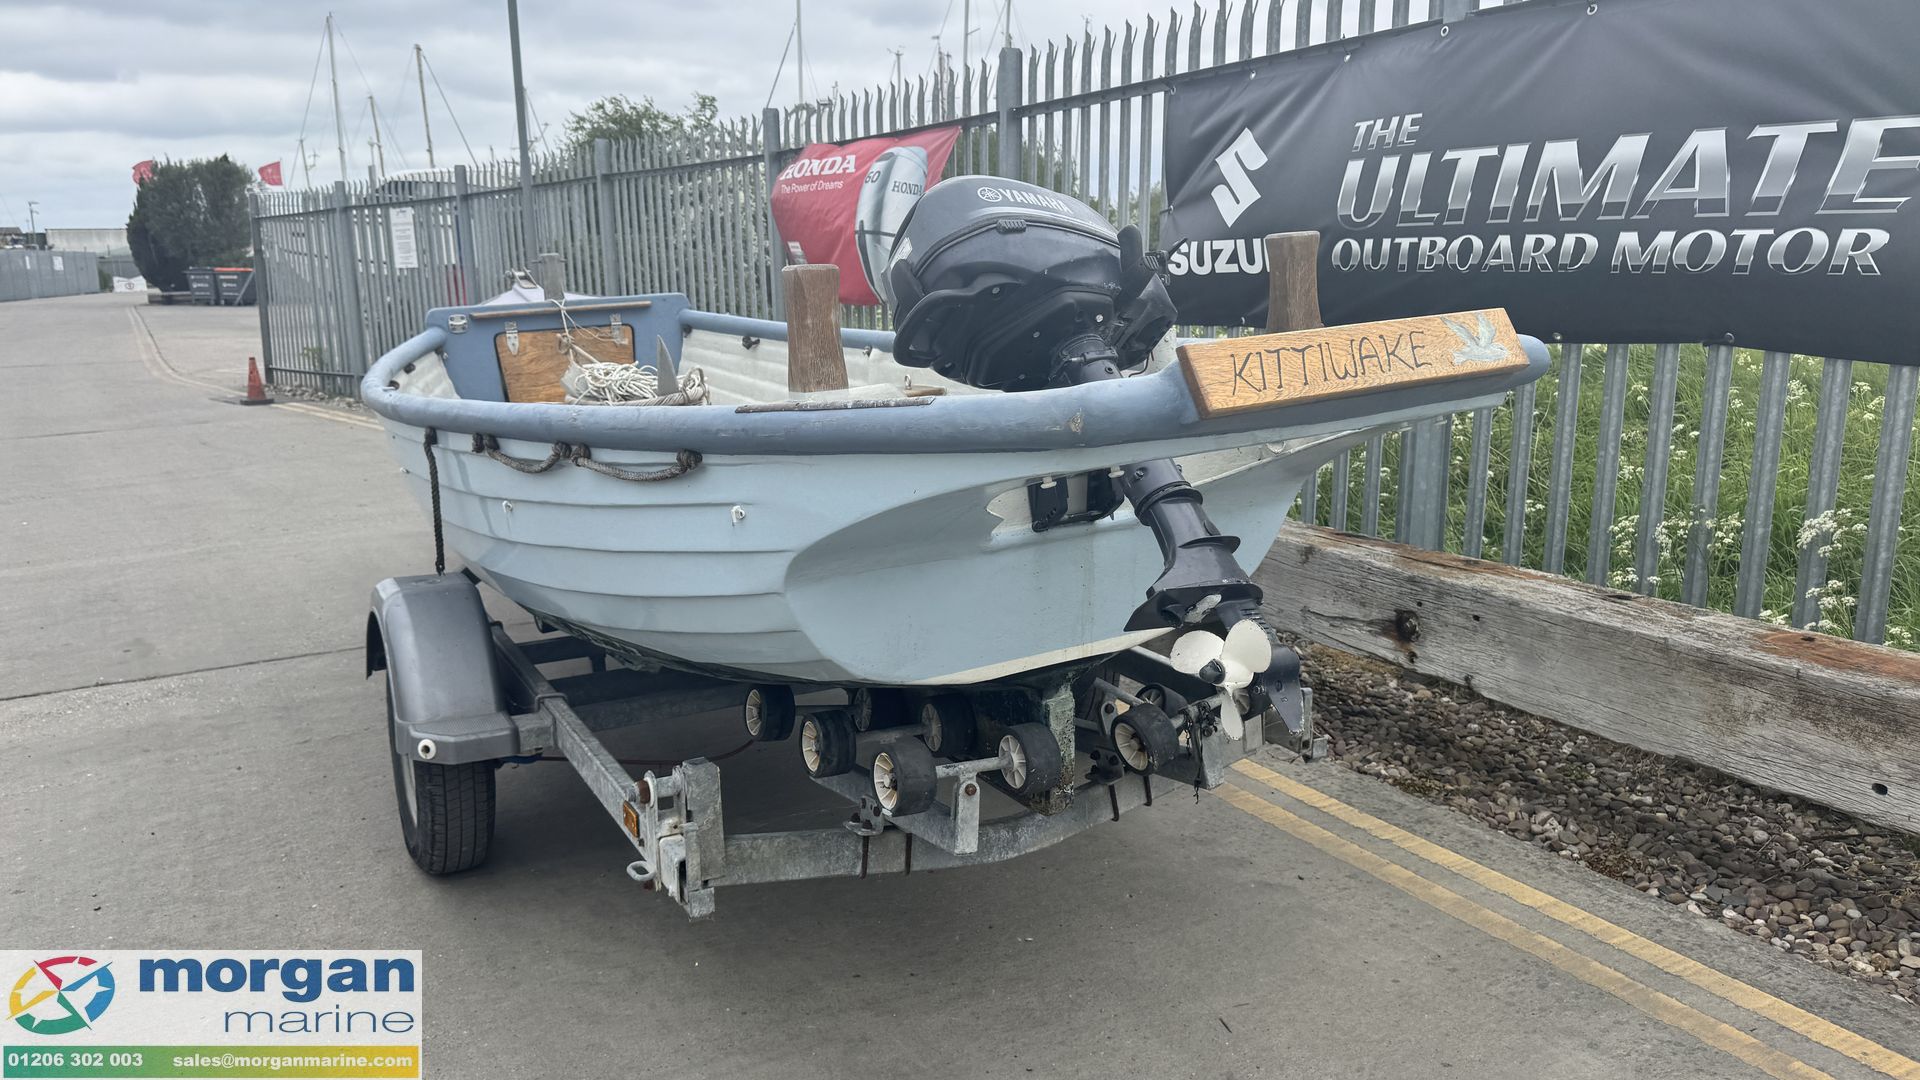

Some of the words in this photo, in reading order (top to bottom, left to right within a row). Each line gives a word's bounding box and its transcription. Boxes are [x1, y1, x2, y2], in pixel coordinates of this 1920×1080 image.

[1351, 113, 1423, 152] THE
[779, 154, 857, 181] HONDA
[781, 184, 790, 193] The
[791, 183, 809, 192] Power
[810, 180, 818, 191] of
[818, 180, 844, 190] Dreams
[864, 170, 881, 184] 60
[1337, 115, 1920, 230] ULTIMATE
[998, 188, 1074, 215] YAMAHA
[1167, 238, 1270, 276] SUZU
[1331, 233, 1599, 273] OUTBOARD
[1610, 227, 1890, 276] MOTOR
[1231, 331, 1432, 396] KITTIWAKE
